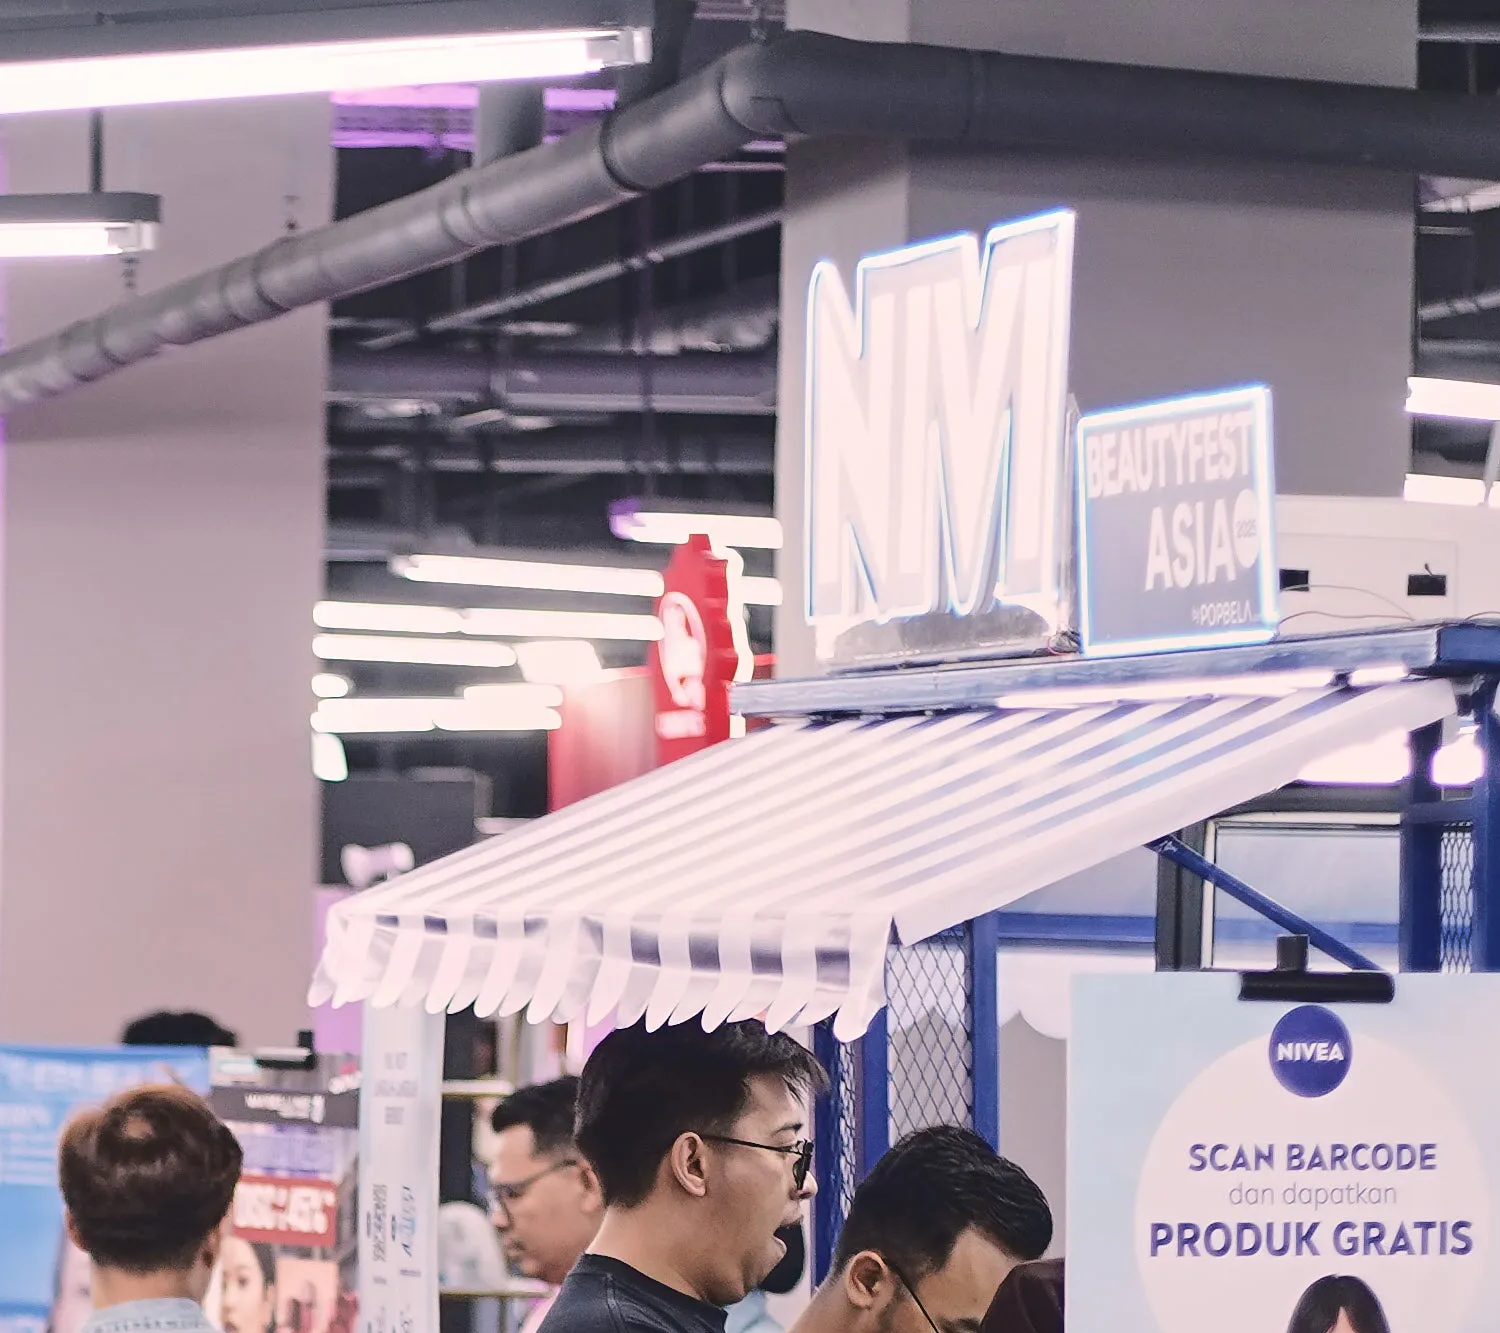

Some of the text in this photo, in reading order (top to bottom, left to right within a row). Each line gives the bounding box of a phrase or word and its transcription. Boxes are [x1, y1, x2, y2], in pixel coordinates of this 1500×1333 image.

[1086, 408, 1254, 499] BEAUTYFEST
[1145, 498, 1236, 592] ASIA
[1276, 1041, 1345, 1062] NIVEA
[1189, 1143, 1437, 1172] SCAN BARCODE
[1229, 1182, 1397, 1211] dan dapatkan
[1150, 1220, 1474, 1258] PRODUK GRATIS
